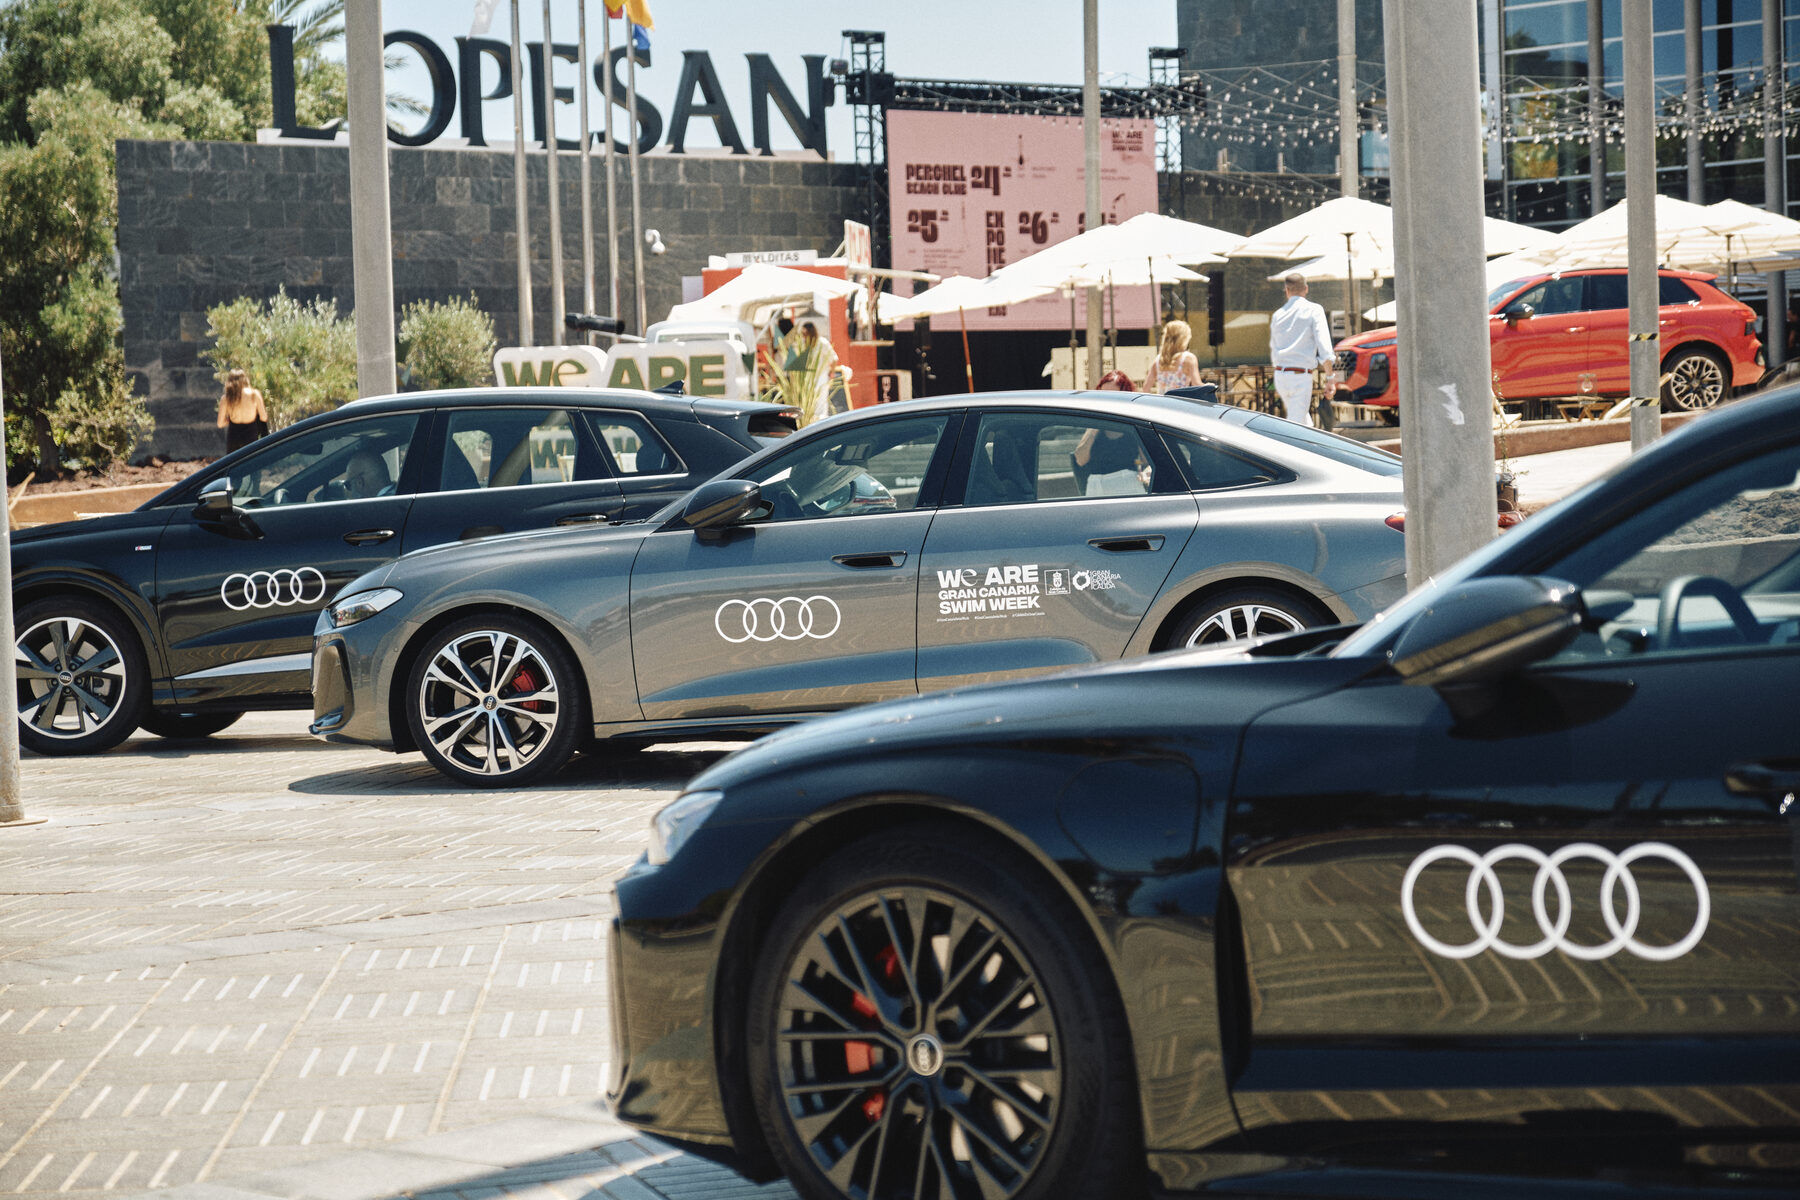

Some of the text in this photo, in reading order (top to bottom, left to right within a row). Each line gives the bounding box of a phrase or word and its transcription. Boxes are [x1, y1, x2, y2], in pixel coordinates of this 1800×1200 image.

[267, 24, 828, 160] LOPESAN
[906, 163, 966, 181] PERCHEL
[608, 354, 726, 396] ARE
[984, 564, 1039, 585] ARE
[938, 588, 977, 600] GRAN
[978, 584, 1040, 598] CANARIA
[940, 596, 1041, 615] SWIM WEEK
